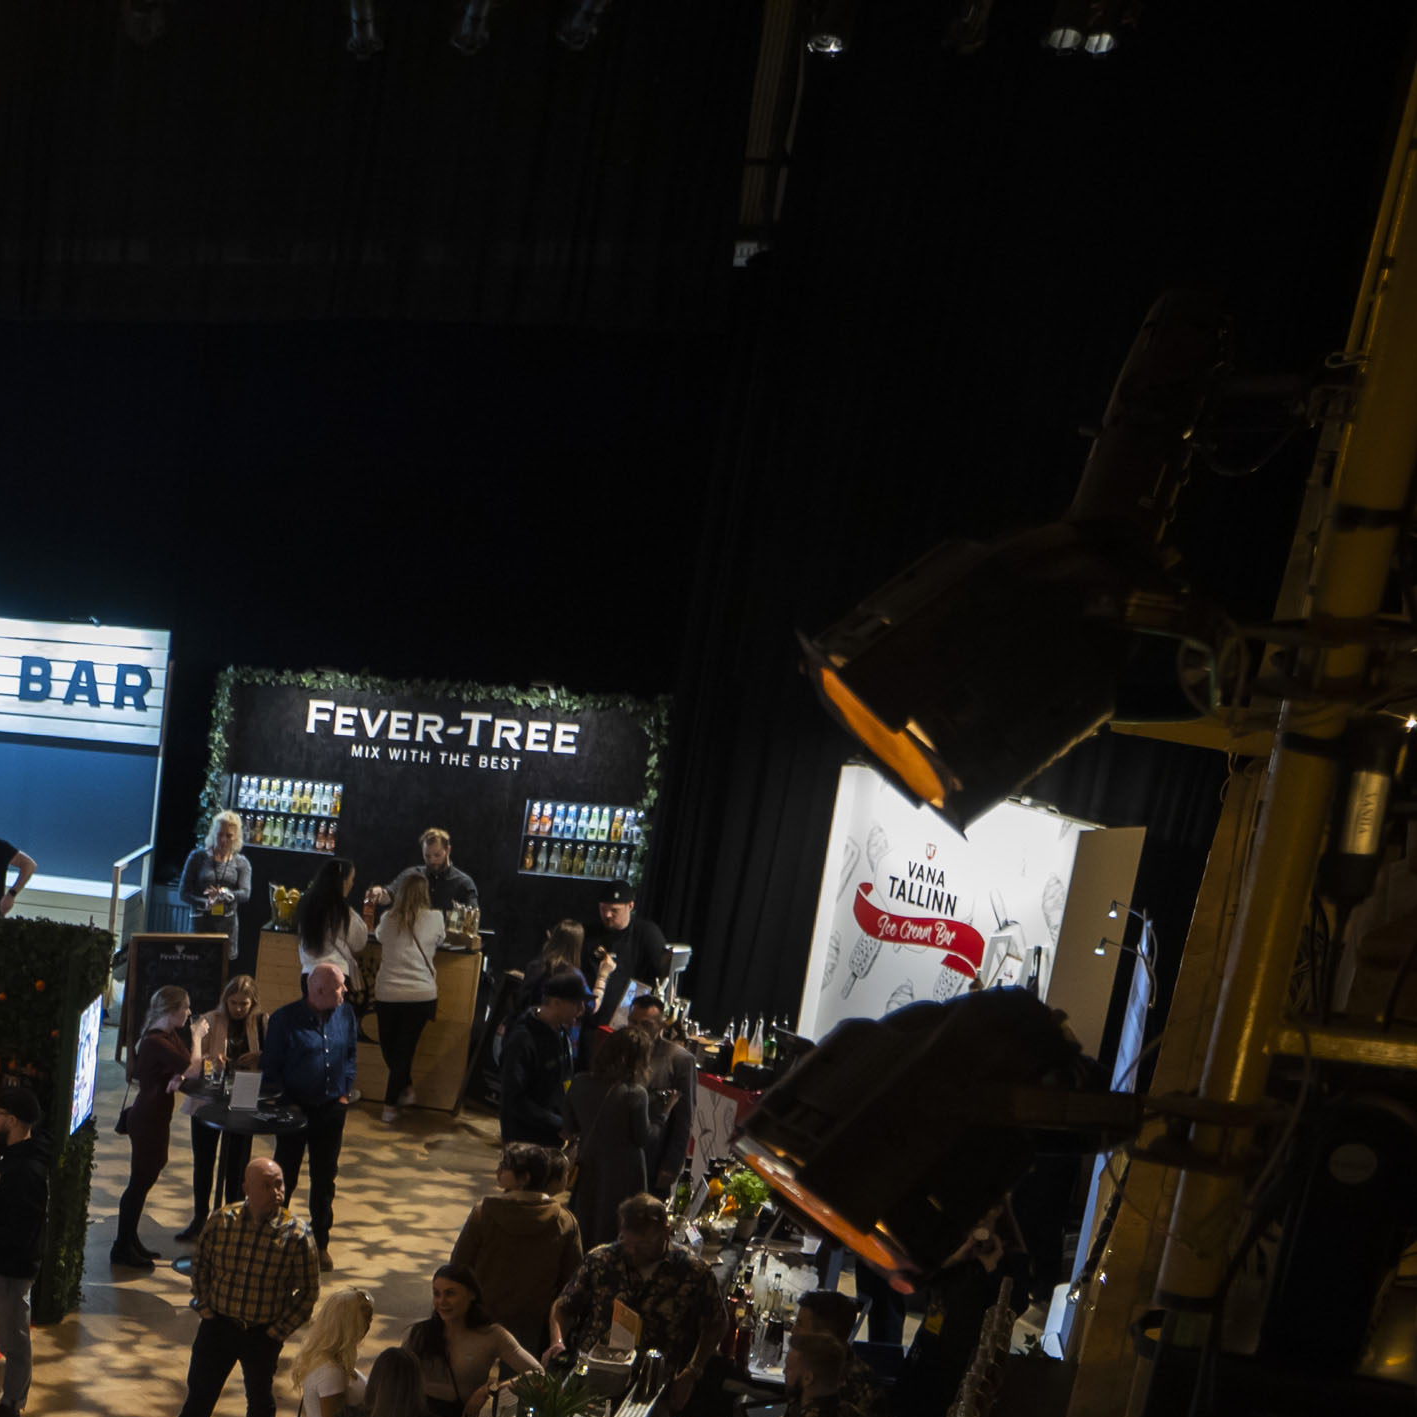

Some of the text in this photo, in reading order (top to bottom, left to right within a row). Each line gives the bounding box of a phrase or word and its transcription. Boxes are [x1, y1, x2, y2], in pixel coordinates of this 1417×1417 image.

[19, 655, 153, 711] BAR
[305, 698, 580, 756] FEVER-TREE
[351, 744, 523, 772] MIX WITH THE BEST
[908, 860, 945, 888] VANA
[888, 875, 958, 918] TALLINN
